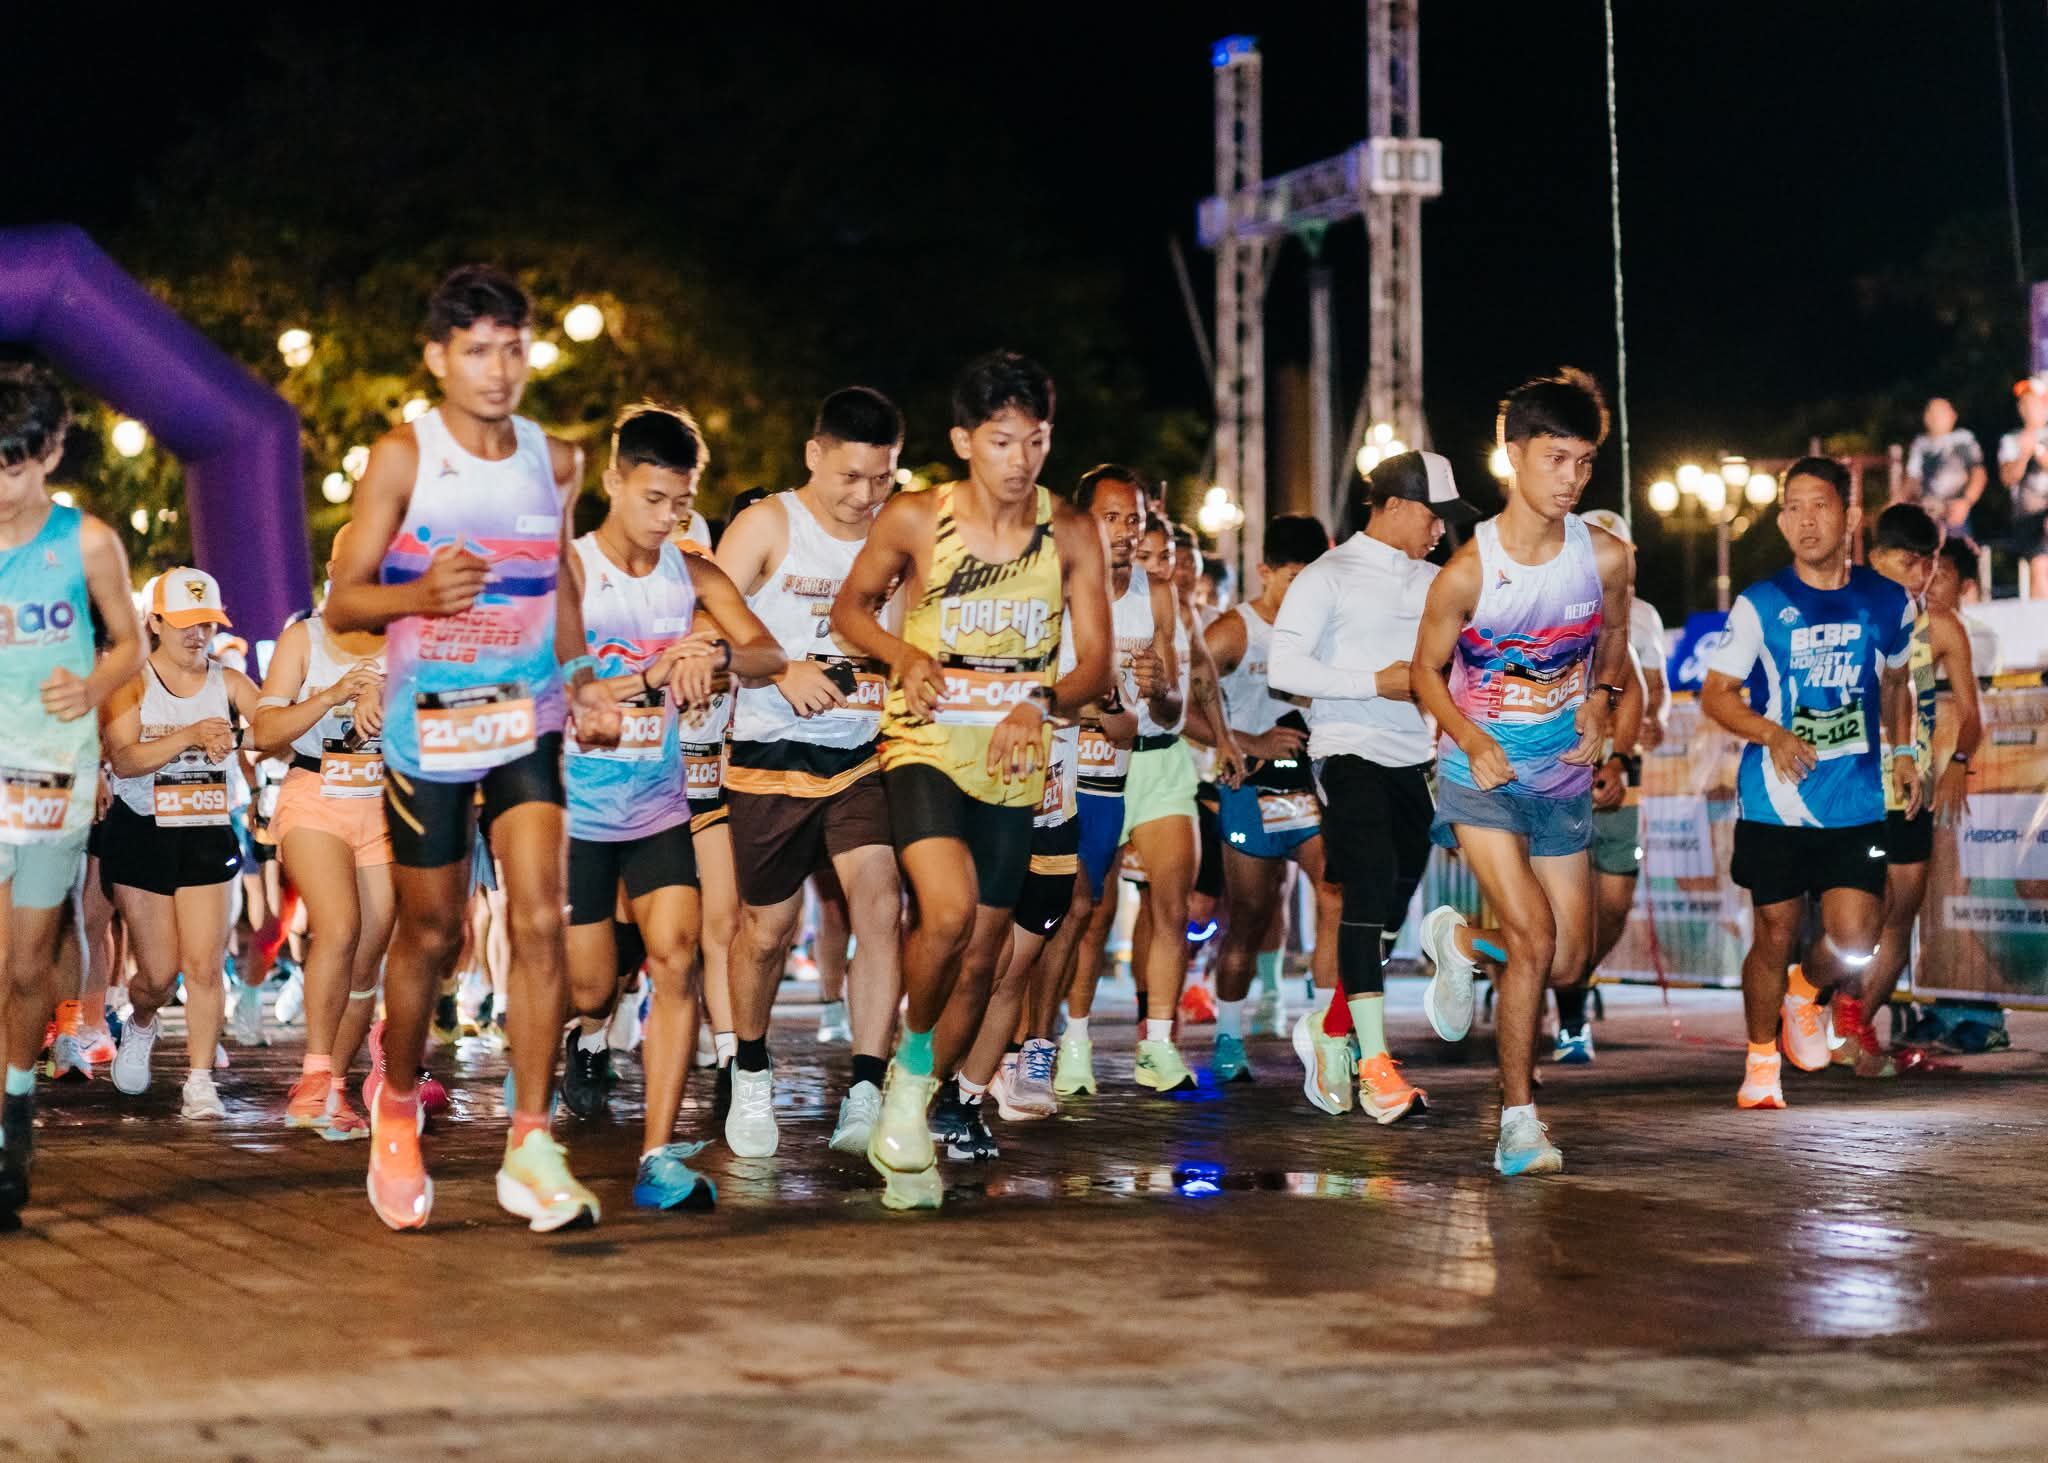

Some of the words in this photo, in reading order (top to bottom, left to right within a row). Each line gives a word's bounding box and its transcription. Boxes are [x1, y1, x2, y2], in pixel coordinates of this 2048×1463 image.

[1791, 623, 1862, 651] BCBP
[1803, 665, 1861, 688] RUN
[423, 709, 529, 747] 21-070
[1795, 718, 1860, 746] 21-112
[156, 789, 225, 812] 21-059
